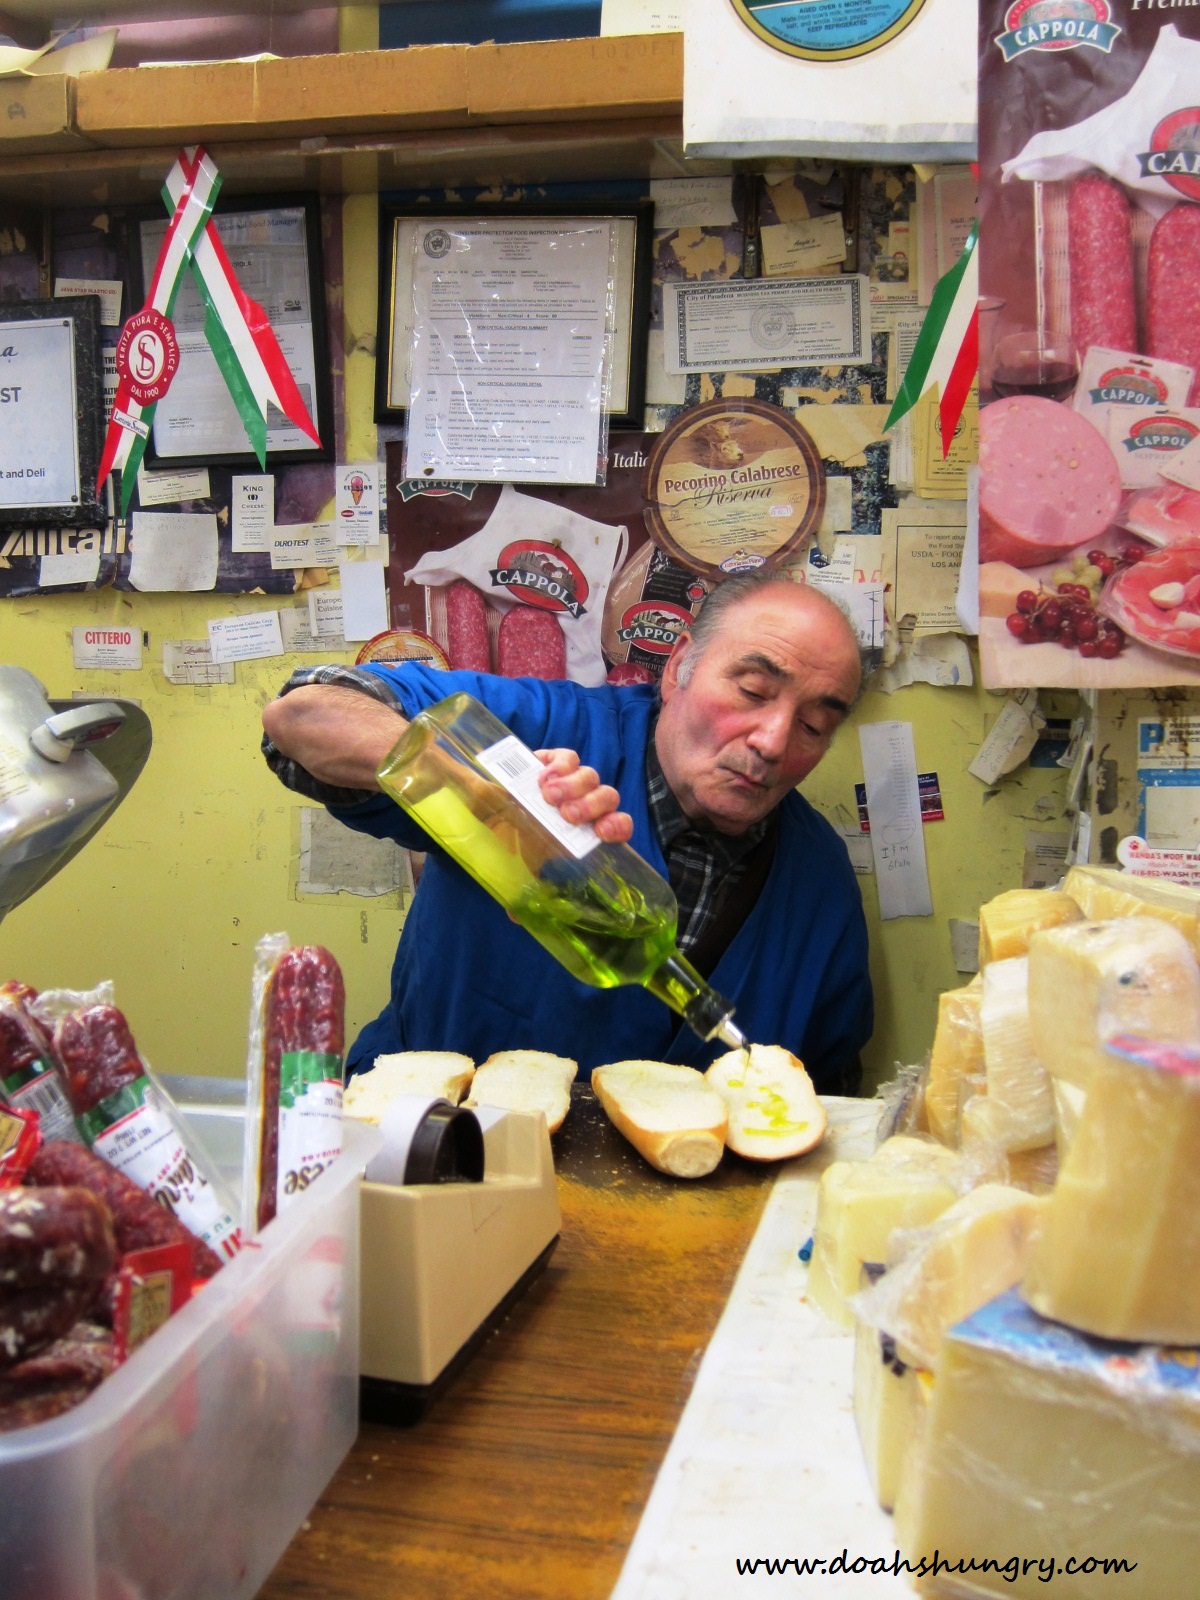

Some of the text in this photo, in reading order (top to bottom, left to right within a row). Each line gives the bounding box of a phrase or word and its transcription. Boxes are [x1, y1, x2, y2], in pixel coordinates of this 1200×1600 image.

[799, 5, 817, 14] AGED
[818, 3, 836, 11] OVER
[807, 25, 823, 33] KEEP
[1014, 20, 1099, 46] CAPPOLA
[686, 294, 699, 302] City
[700, 293, 706, 301] of
[131, 315, 151, 331] PURA
[153, 317, 158, 326] E
[159, 321, 176, 372] SEMPLICE
[130, 384, 159, 399] DAL 1900
[5, 469, 24, 479] and
[26, 467, 46, 478] Deli
[664, 463, 801, 494] Pecorino Calabrese
[693, 482, 773, 510] Riserva
[933, 533, 951, 541] report
[911, 550, 934, 558] USDA
[496, 569, 579, 618] CAPPOLA
[316, 597, 343, 606] Europe
[211, 624, 223, 632] EC
[622, 626, 679, 644] CAPPO
[85, 631, 132, 646] CITTERIO
[1140, 722, 1165, 753] P
